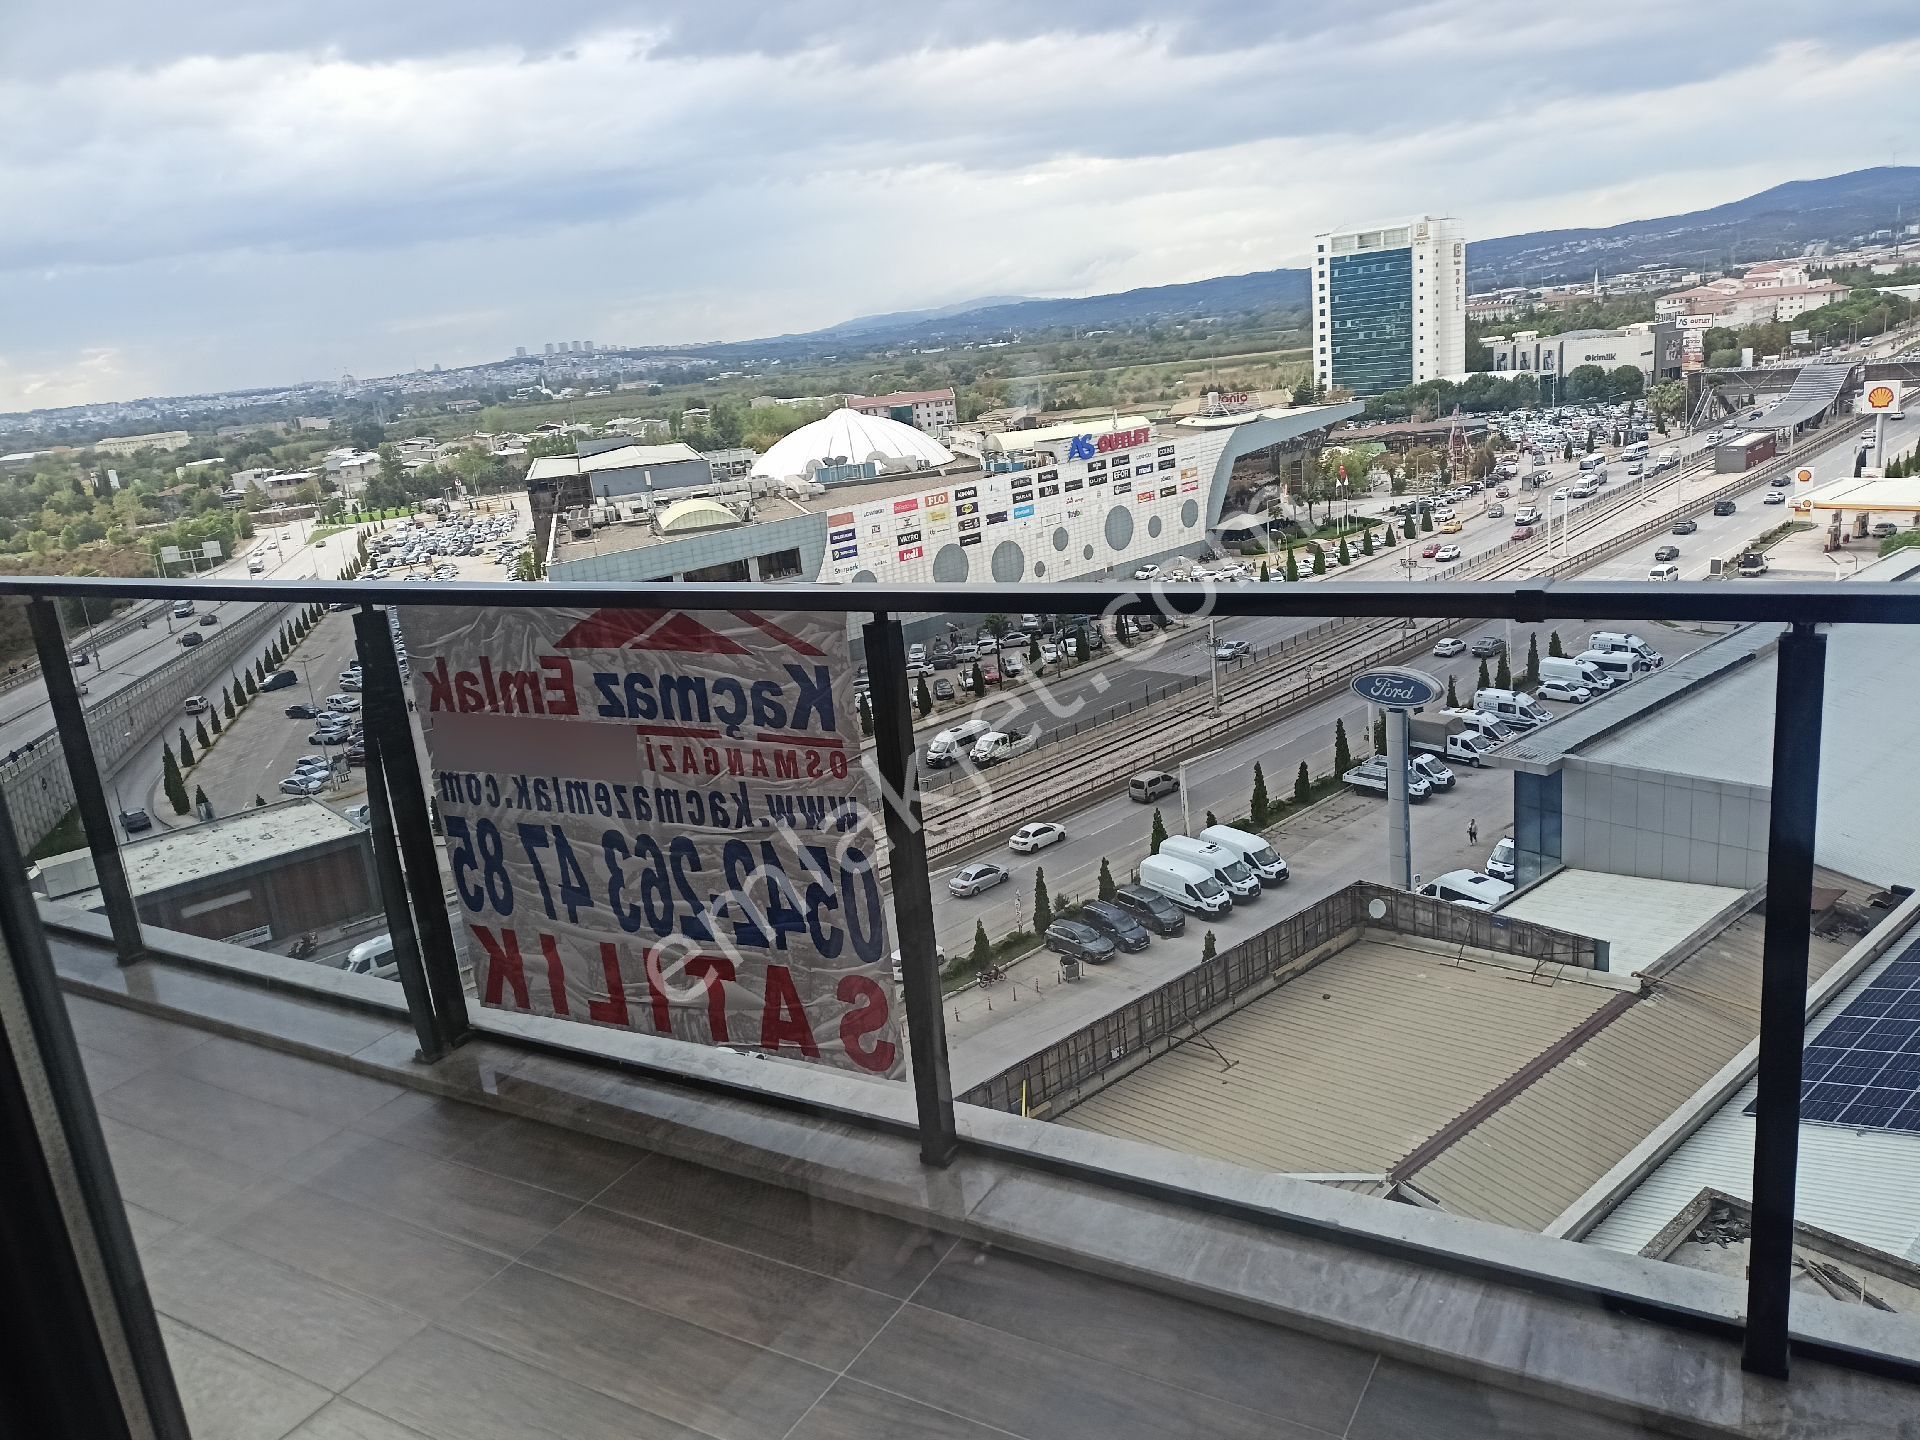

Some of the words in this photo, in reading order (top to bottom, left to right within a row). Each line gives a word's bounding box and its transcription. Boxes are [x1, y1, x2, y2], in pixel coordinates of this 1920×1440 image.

[1067, 433, 1096, 461] AS
[1097, 427, 1151, 453] OUTLET
[1113, 469, 1129, 480] EFOR
[927, 494, 946, 506] FLO
[1370, 677, 1415, 700] Ford
